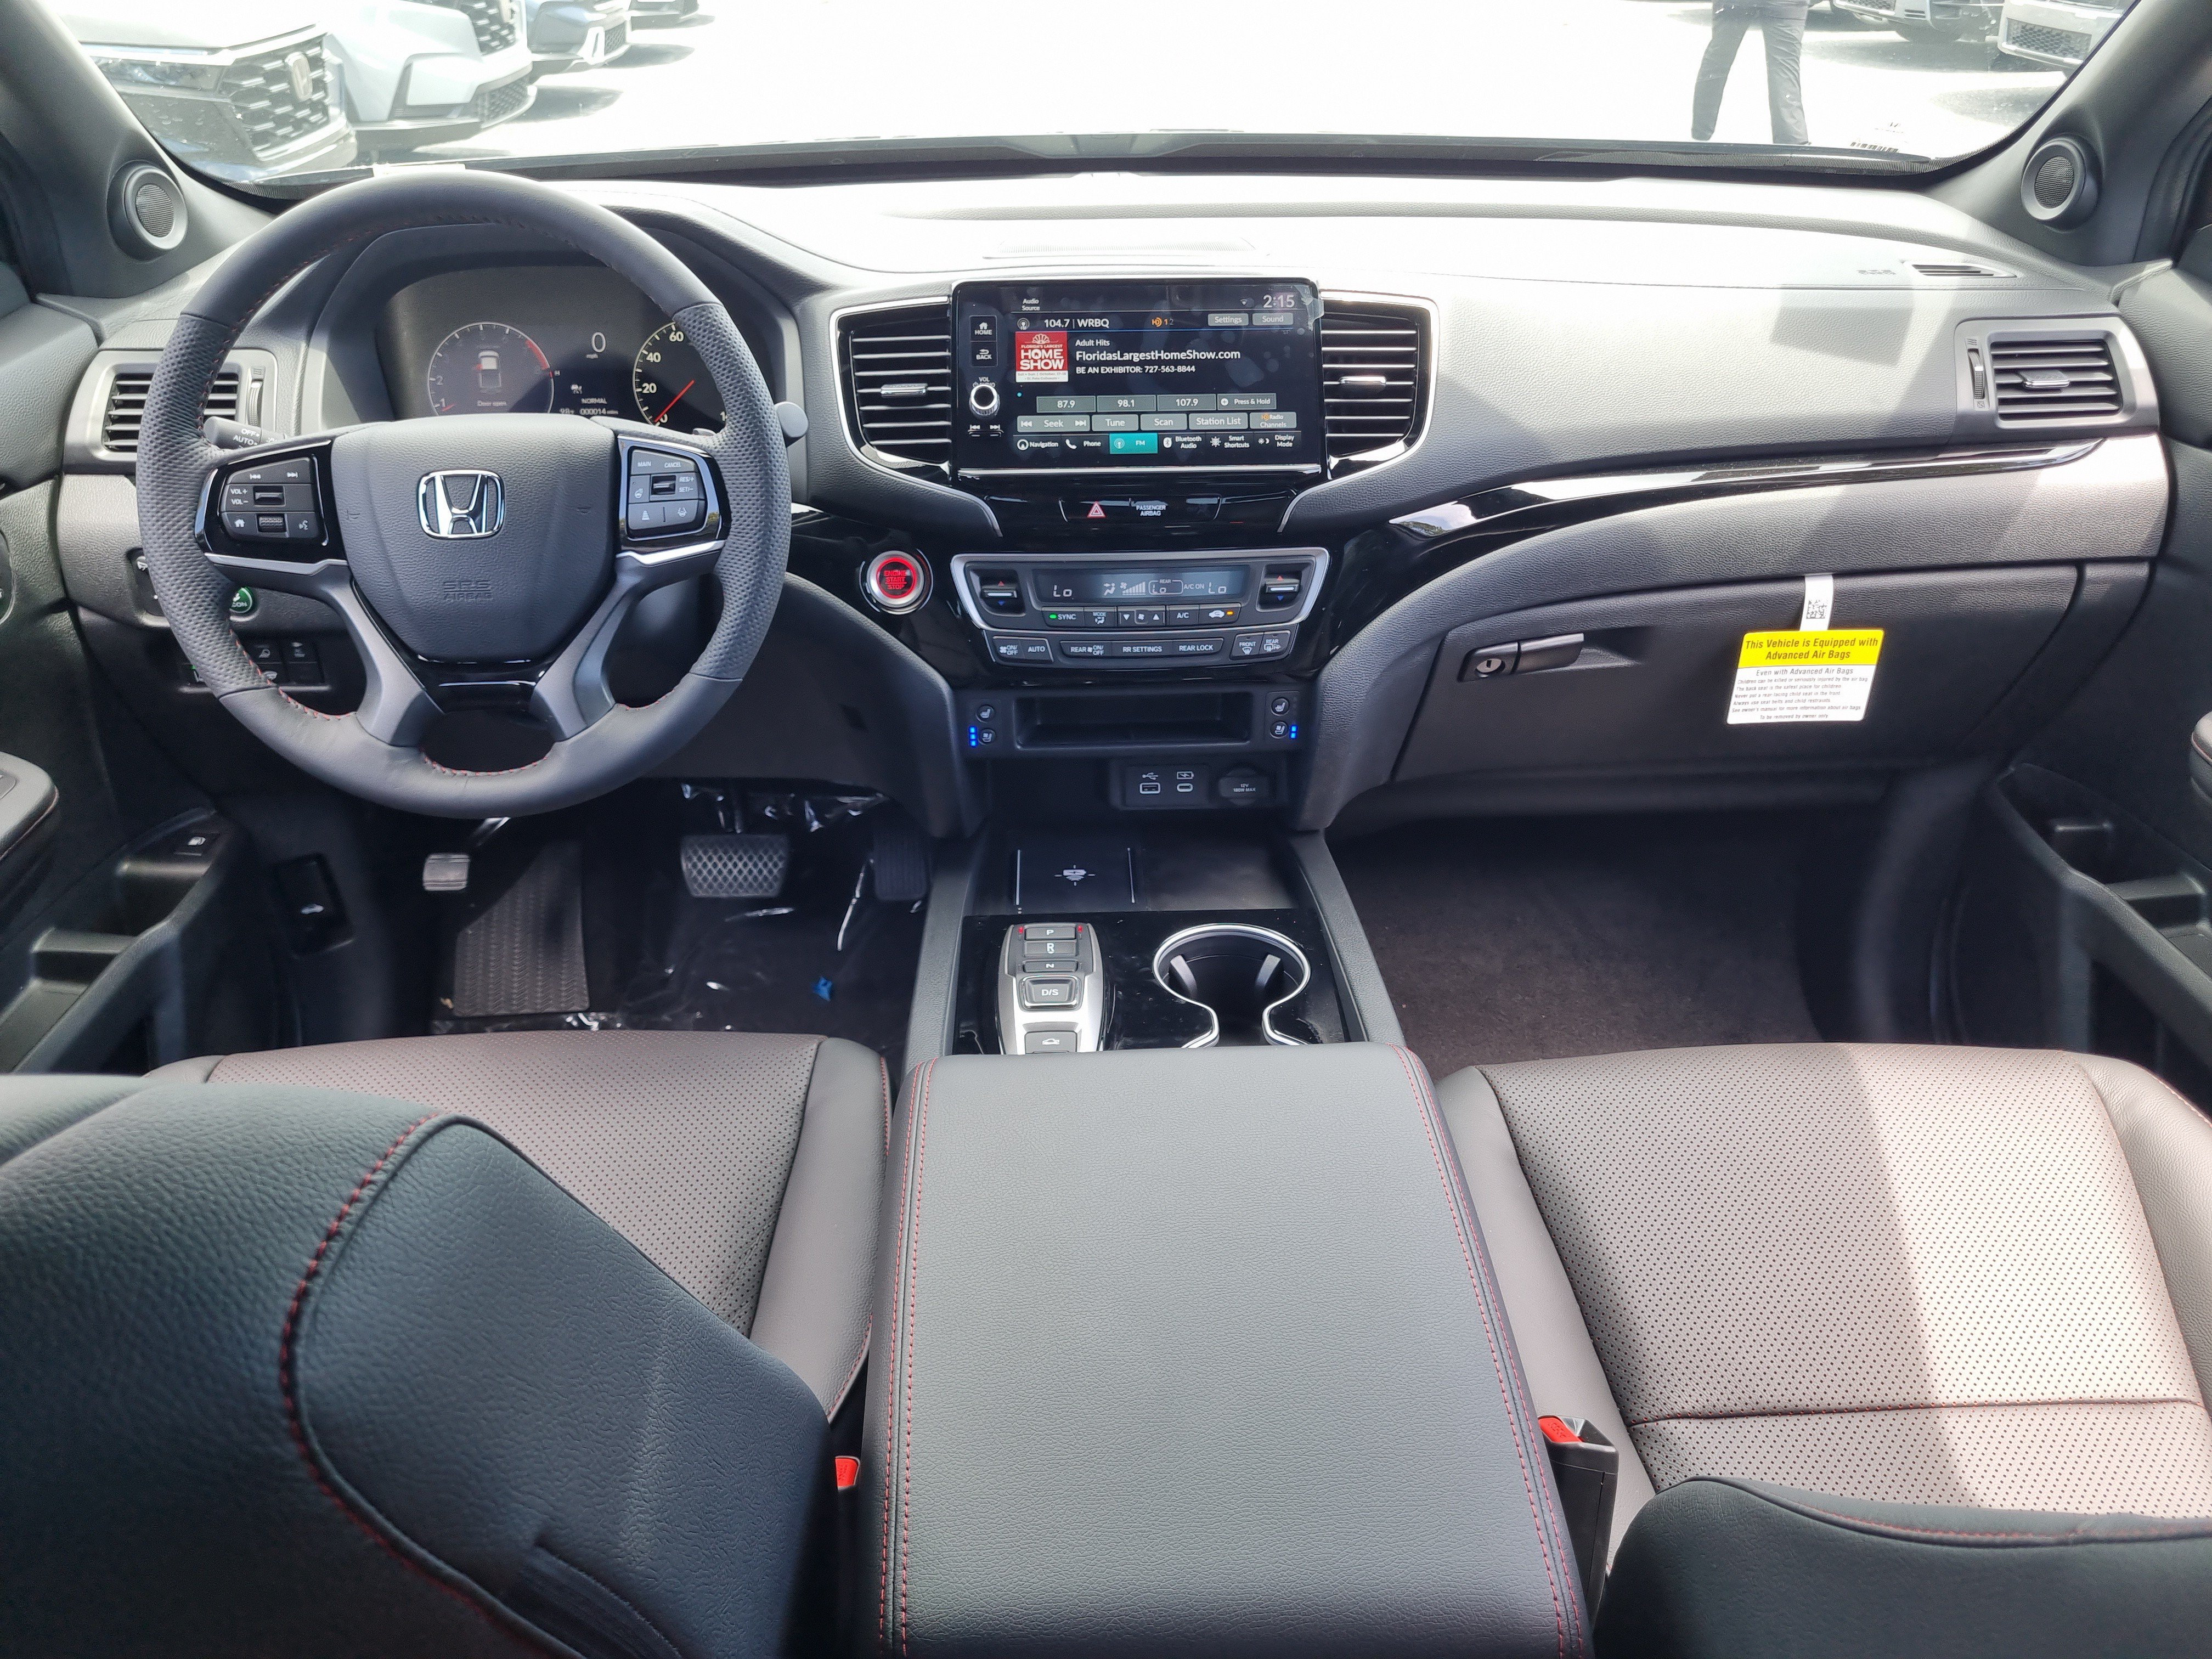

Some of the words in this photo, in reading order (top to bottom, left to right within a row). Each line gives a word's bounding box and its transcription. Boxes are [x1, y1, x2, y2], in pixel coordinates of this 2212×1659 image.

[1263, 295, 1295, 308] 2:15
[1044, 319, 1070, 327] 104.7
[1077, 319, 1109, 328] WRBQ
[669, 331, 684, 342] 60
[591, 332, 606, 352] 0
[646, 352, 661, 363] 40
[1021, 349, 1063, 359] HOME
[1076, 351, 1240, 362] FloridasLargestHomeShow.com
[1020, 359, 1064, 370] SHOW
[437, 376, 443, 385] 2
[642, 383, 657, 393] 20
[441, 398, 445, 408] 1
[1118, 399, 1135, 408] 98.1
[1154, 418, 1173, 426] Scan
[233, 435, 254, 445] AUTO
[1053, 585, 1073, 597] Lo
[1208, 582, 1226, 594] Lo
[1746, 640, 1763, 650] This
[1767, 639, 1799, 648] Vehicle
[1802, 639, 1810, 647] is
[1813, 638, 1856, 648] Equipped
[1859, 637, 1878, 646] with
[1765, 651, 1810, 660] Advanced
[1827, 650, 1850, 660] Bags
[1047, 943, 1054, 952] R
